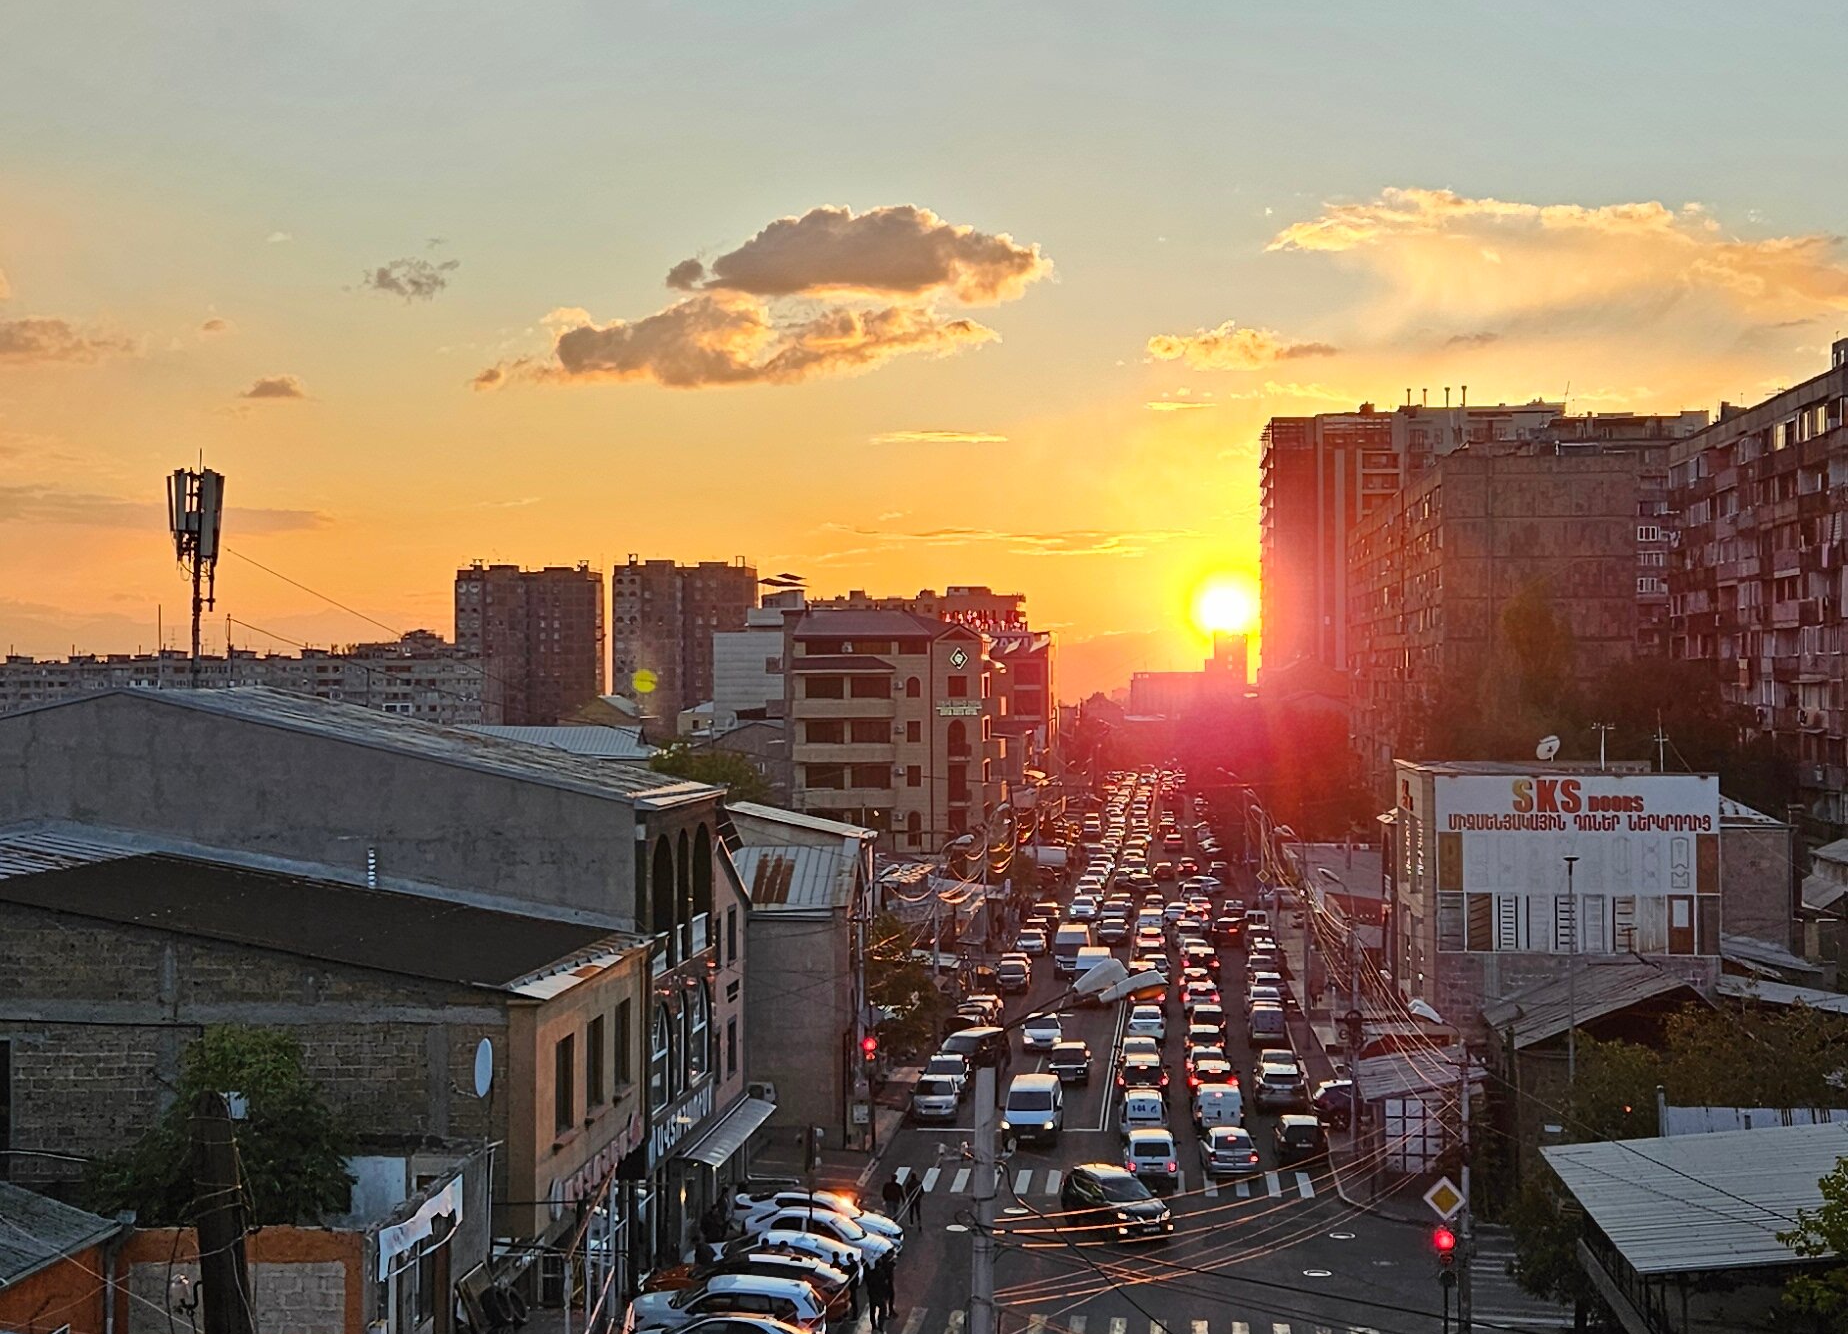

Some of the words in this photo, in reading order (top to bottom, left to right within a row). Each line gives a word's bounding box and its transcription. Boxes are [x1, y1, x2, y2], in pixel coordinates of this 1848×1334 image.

[1512, 779, 1581, 813] SKS
[1588, 795, 1644, 812] DOORS
[1448, 814, 1566, 831] ՄԻՋՍԵՆՅԱԿԱՅԻՆ
[1574, 814, 1620, 831] ԴՌՆԵՐ
